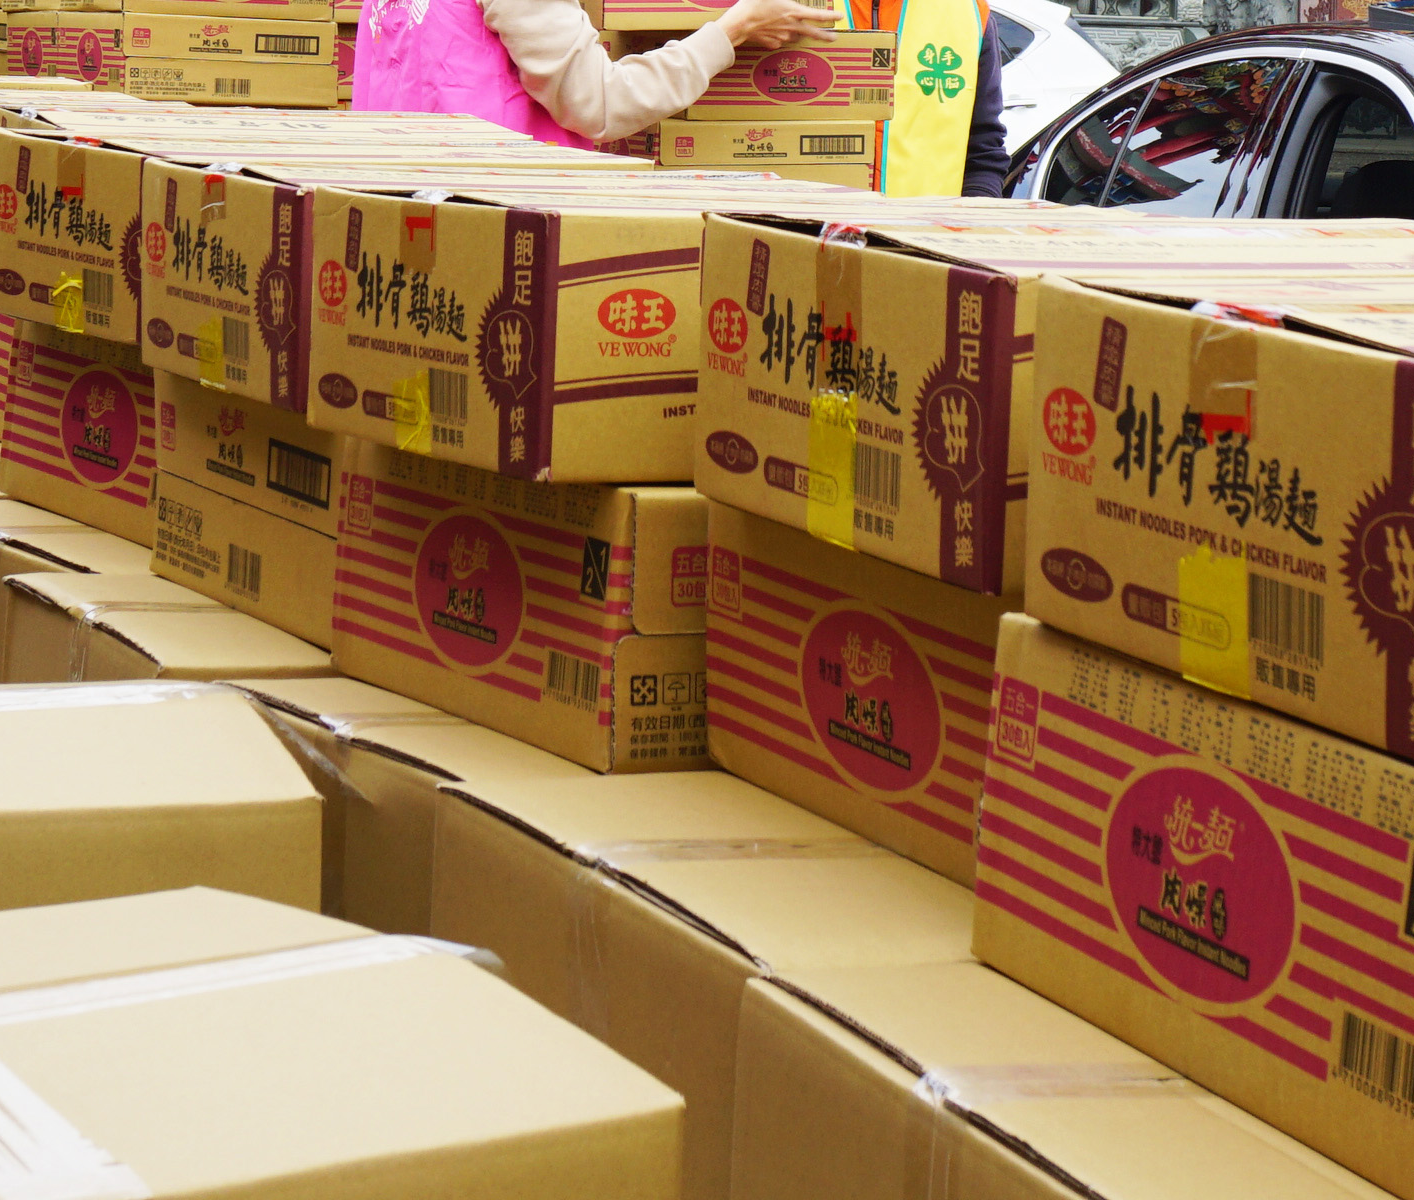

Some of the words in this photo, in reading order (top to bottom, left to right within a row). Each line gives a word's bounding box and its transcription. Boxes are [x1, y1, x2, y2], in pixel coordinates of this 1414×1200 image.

[513, 229, 534, 306] 飽足
[608, 295, 667, 333] 味王
[712, 301, 745, 350] 味王
[958, 289, 983, 383] 飽足
[747, 387, 777, 409] INSTANT
[778, 394, 811, 419] NOODLES
[940, 394, 970, 465] 拼
[1048, 392, 1091, 451] 味王
[509, 405, 526, 464] 快樂
[954, 499, 974, 568] 快樂
[1095, 497, 1138, 529] INSTANT
[1138, 508, 1187, 541] NOODLES
[1188, 523, 1218, 550] PORK
[1230, 535, 1284, 570] CHICKEN
[1285, 550, 1327, 585] FLAVOR
[1003, 685, 1035, 719] 五合一
